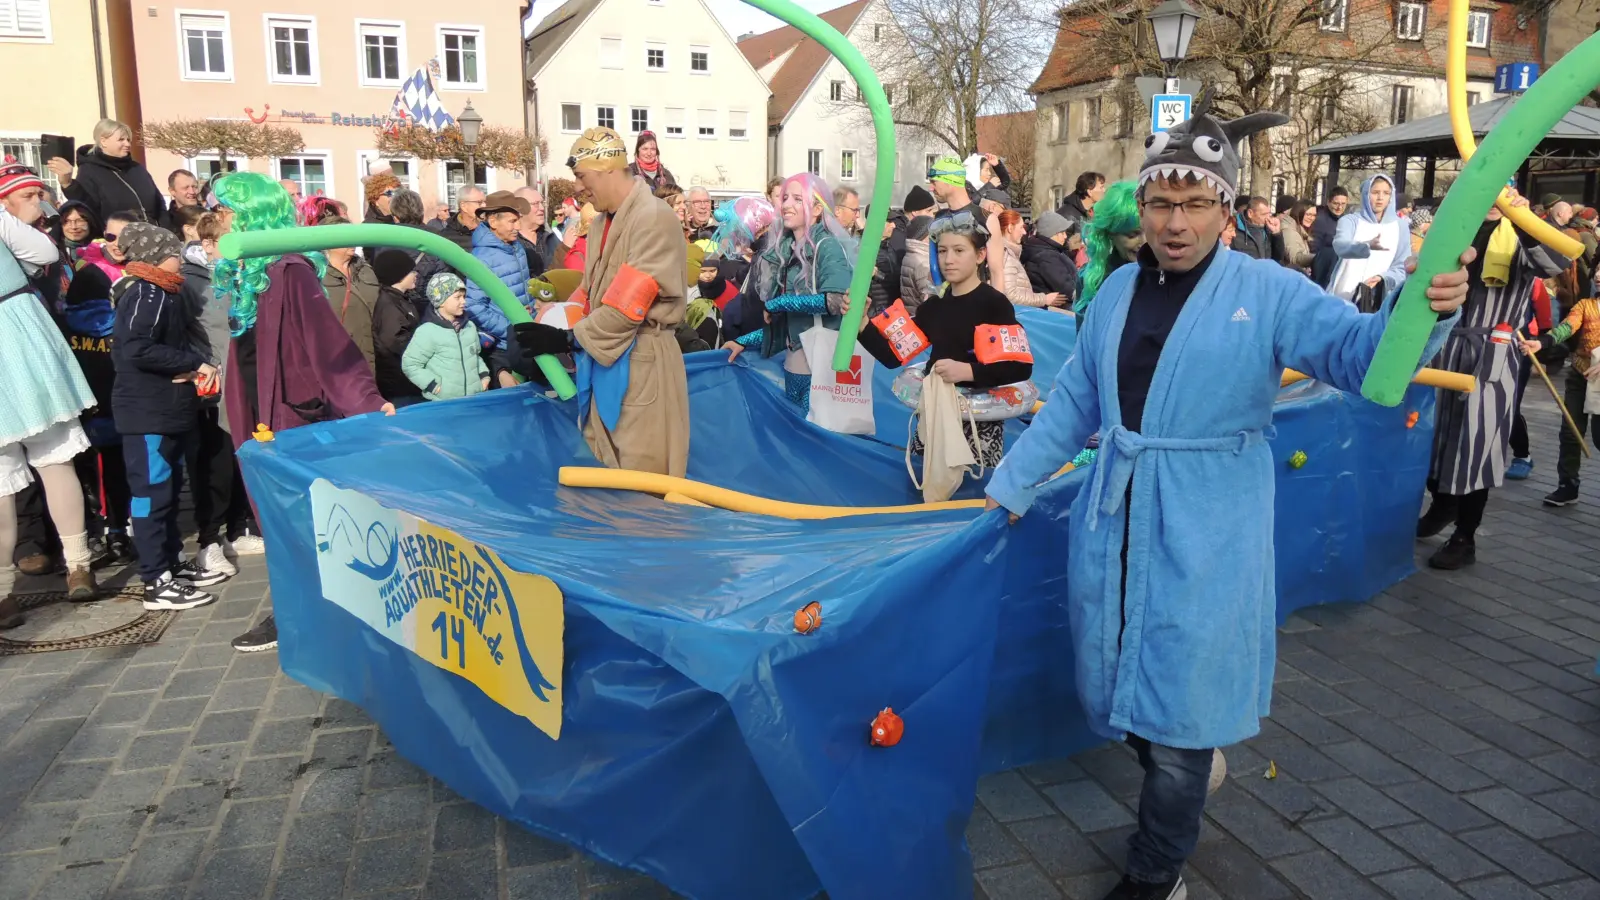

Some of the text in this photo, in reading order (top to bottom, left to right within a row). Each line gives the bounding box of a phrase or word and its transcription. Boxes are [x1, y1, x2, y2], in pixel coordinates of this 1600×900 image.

[1162, 103, 1182, 114] WC
[71, 335, 113, 353] S.W.A.
[835, 385, 862, 396] BUCH
[378, 568, 404, 599] www.
[431, 611, 466, 670] 14
